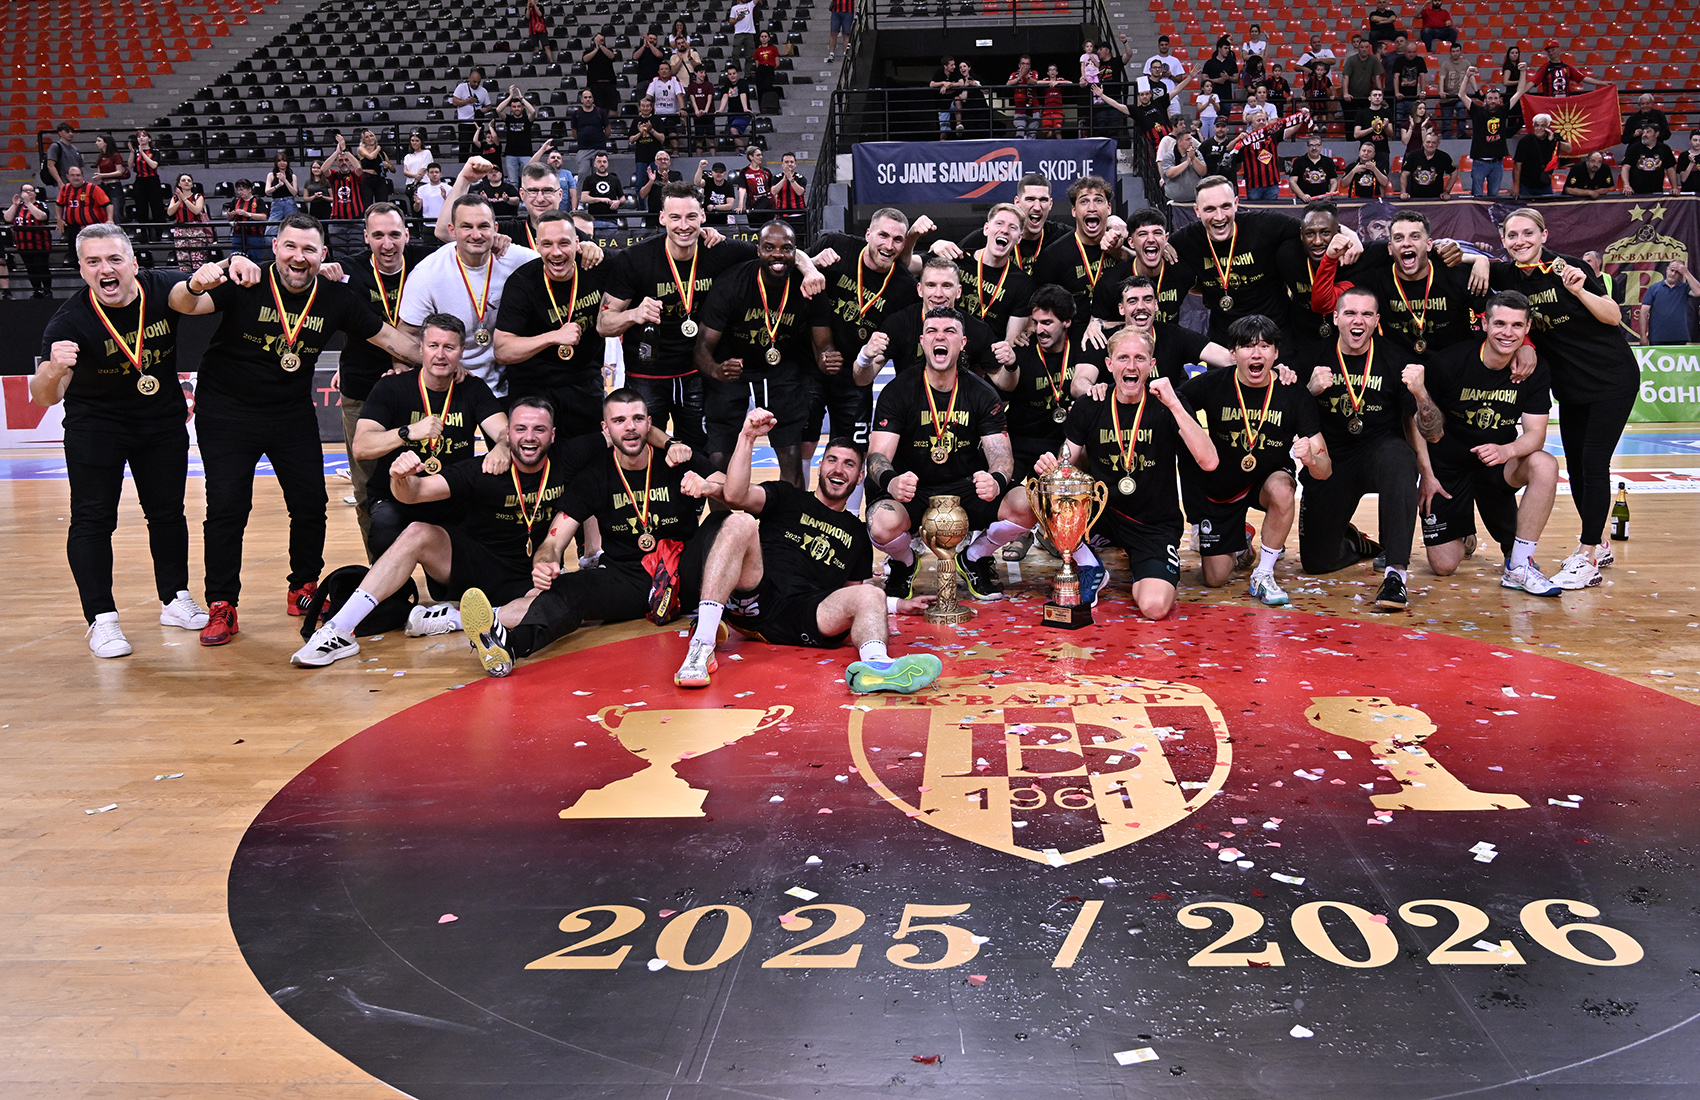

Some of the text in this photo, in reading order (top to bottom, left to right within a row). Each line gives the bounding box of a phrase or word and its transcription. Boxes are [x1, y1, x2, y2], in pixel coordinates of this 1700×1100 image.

[877, 163, 896, 184] SC
[899, 163, 936, 183] JANE
[939, 161, 1022, 183] SANDANSKI
[1552, 314, 1570, 327] 2026
[242, 332, 262, 344] 2025
[1460, 387, 1518, 405] ШАМПИОНИ
[1366, 404, 1383, 412] 2026
[914, 440, 930, 449] 2025
[1266, 437, 1284, 448] 2026
[495, 512, 515, 522] 2025
[611, 515, 680, 533] 2025 2026
[800, 512, 853, 550] ШАМПИОНИ
[784, 530, 846, 571] 2025 2026
[965, 787, 1134, 810] 1961
[524, 904, 981, 972] 2025
[1177, 898, 1645, 968] 2026
